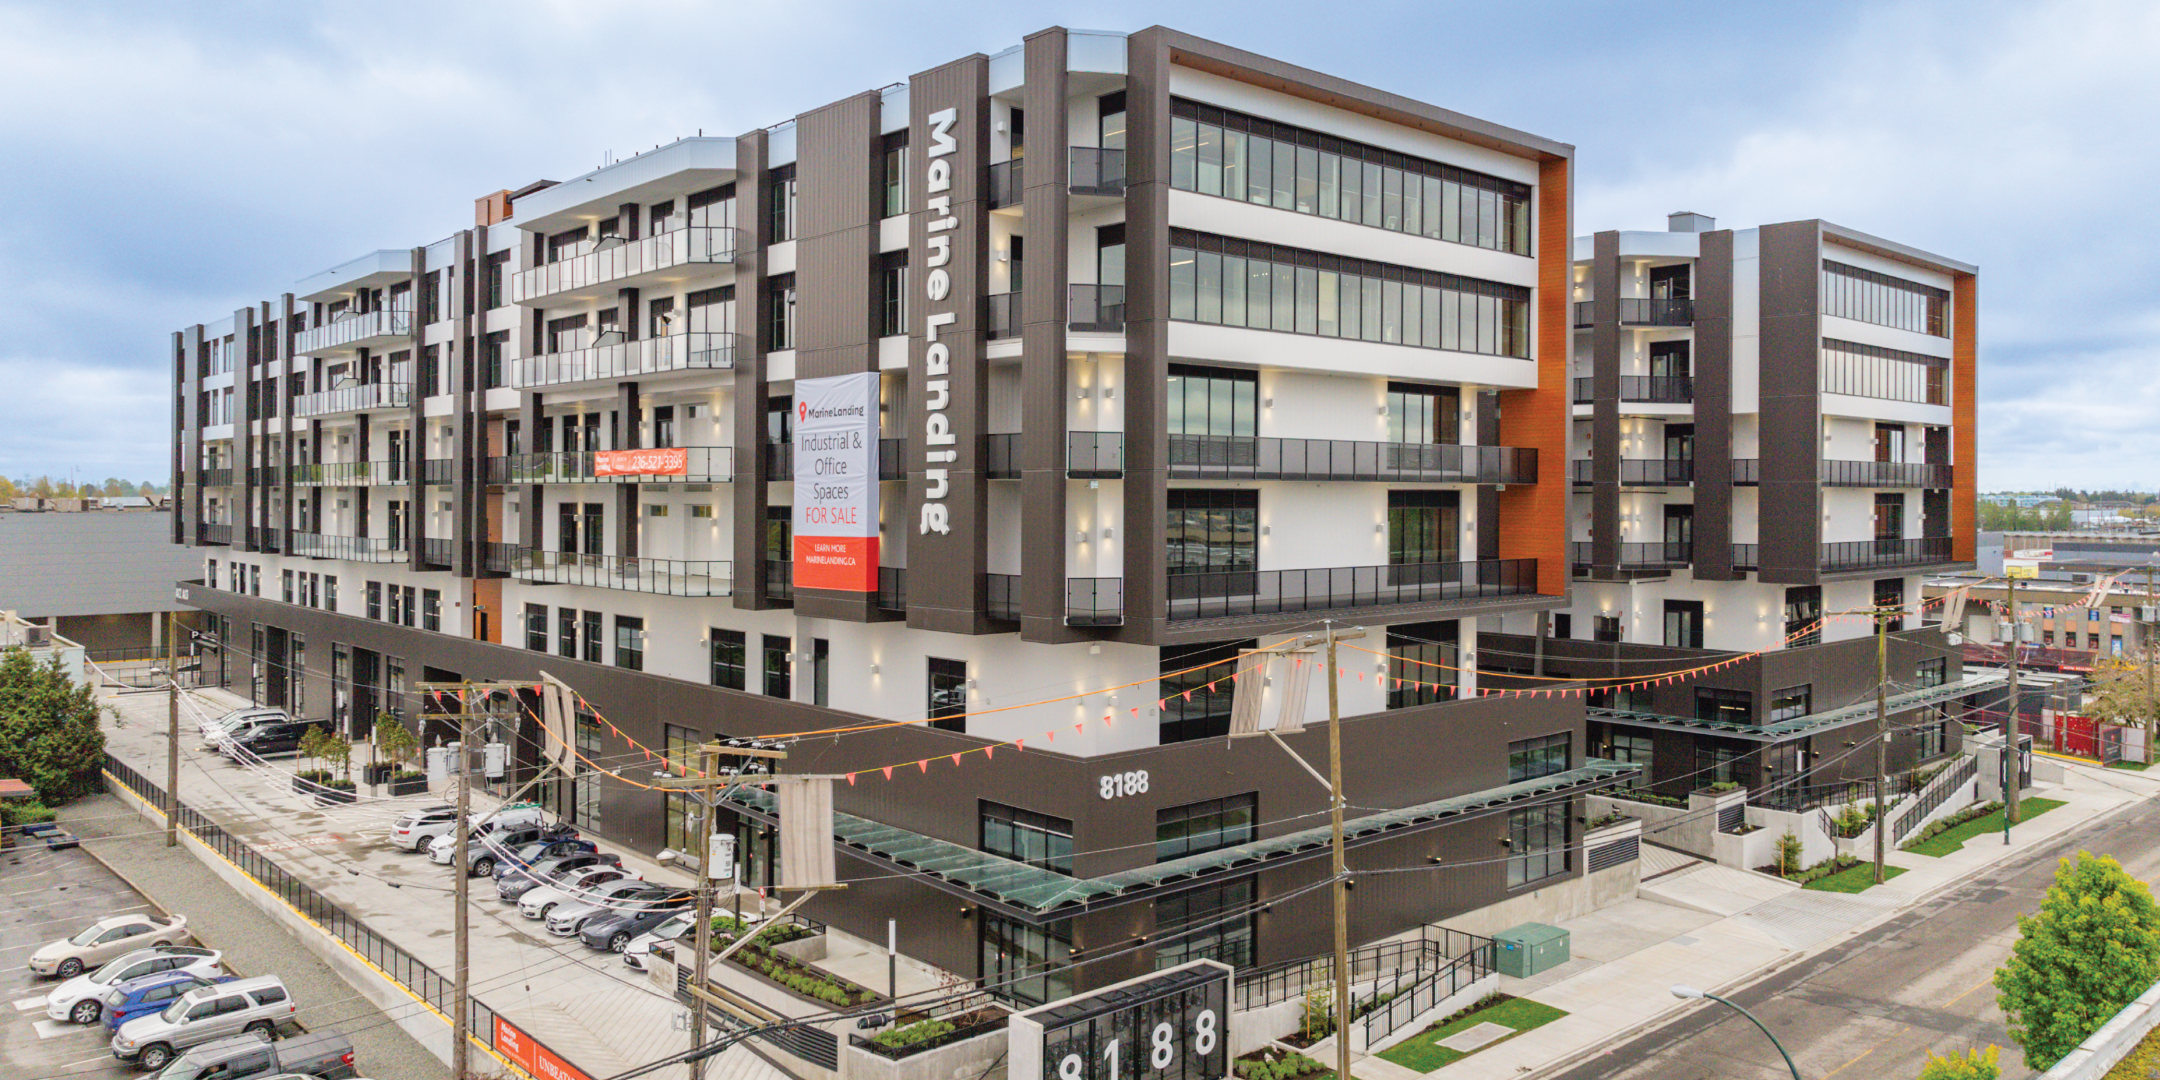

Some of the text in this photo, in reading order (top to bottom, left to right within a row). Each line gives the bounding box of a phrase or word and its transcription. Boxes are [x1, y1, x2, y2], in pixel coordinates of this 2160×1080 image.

[920, 107, 958, 536] Marine Landing
[801, 431, 863, 452] Industrial &
[814, 457, 848, 476] Office
[813, 482, 849, 505] Spaces
[805, 507, 857, 525] FOR SALE
[814, 543, 847, 554] LEARN MORE
[805, 555, 856, 566] MARINELANDING.CA
[191, 631, 199, 639] P
[1100, 769, 1149, 800] 8188
